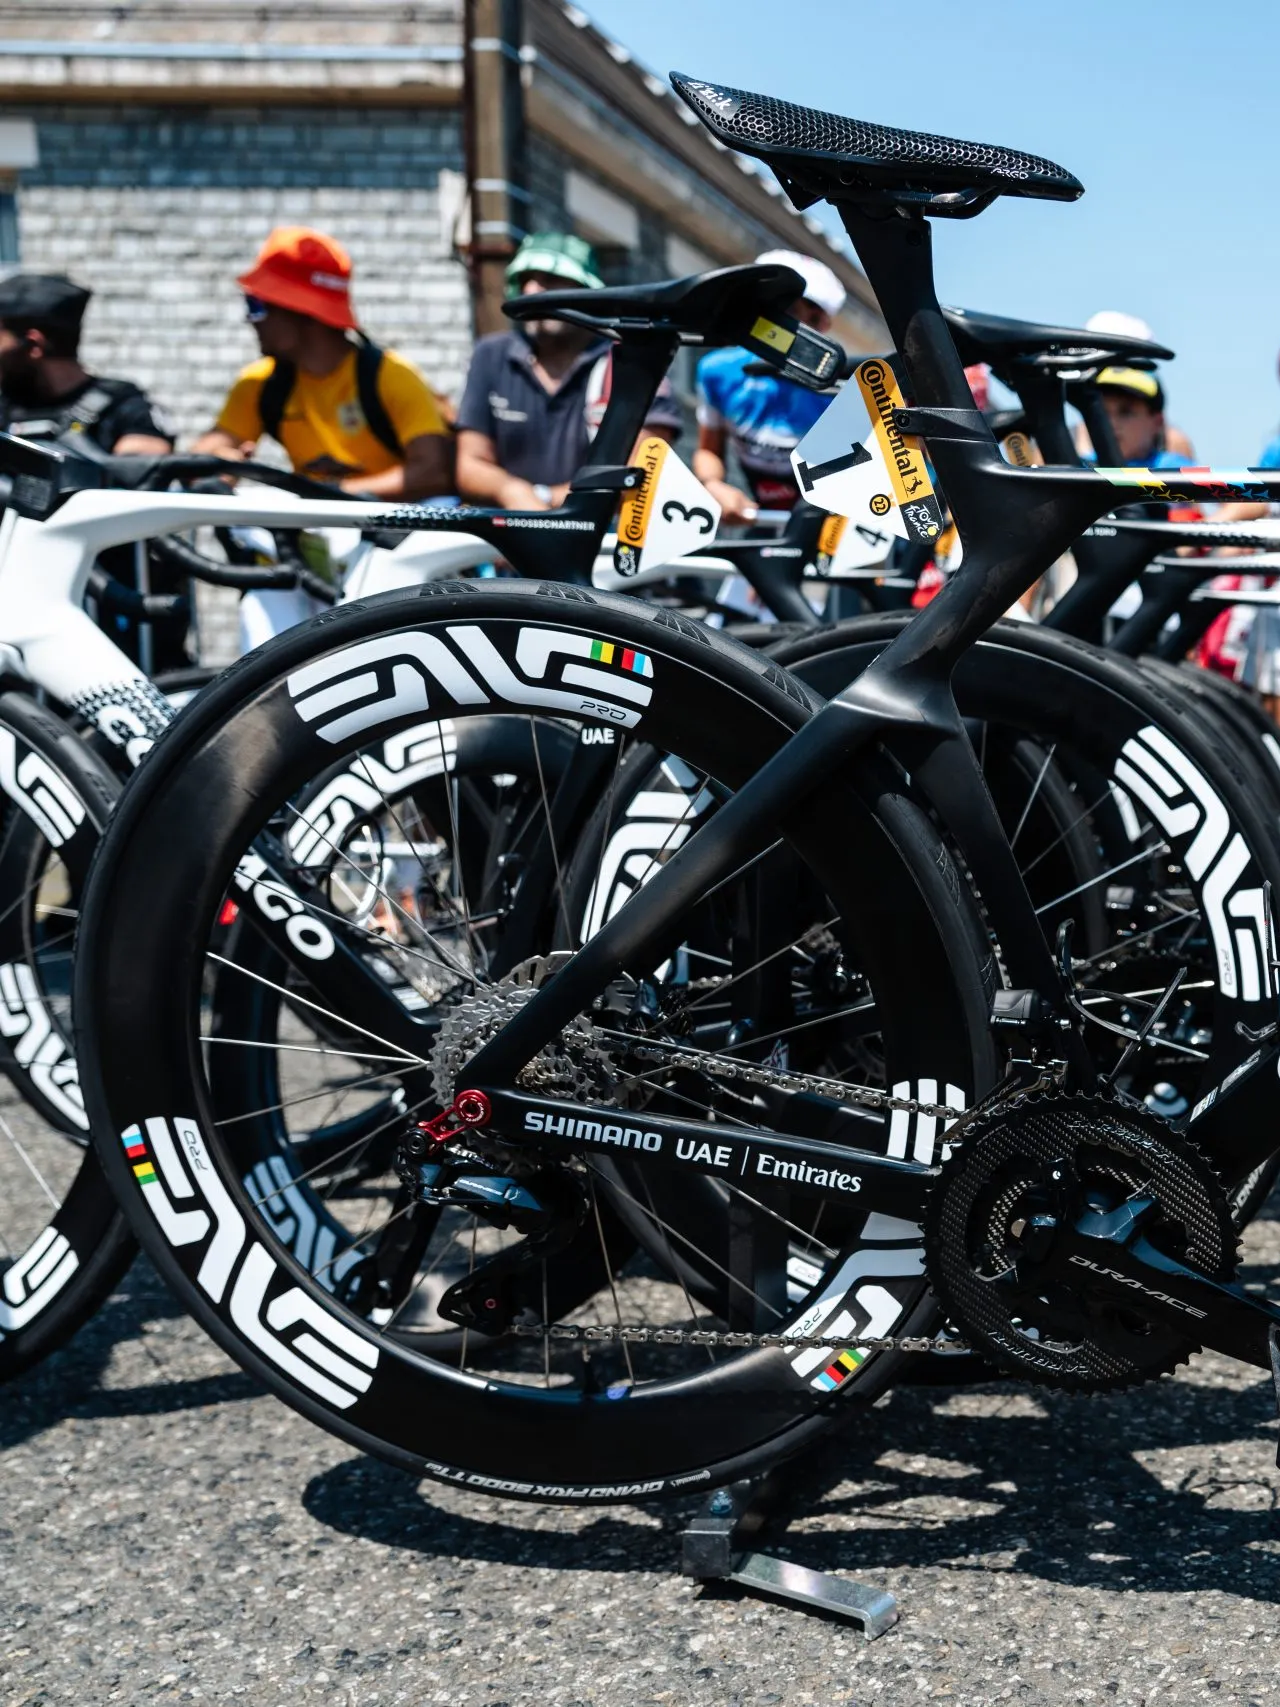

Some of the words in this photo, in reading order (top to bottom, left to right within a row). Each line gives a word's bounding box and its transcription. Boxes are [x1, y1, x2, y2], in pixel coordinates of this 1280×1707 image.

[990, 167, 1029, 180] ARGO
[860, 360, 918, 478] Continental
[797, 441, 873, 492] 1
[662, 500, 714, 535] 3
[855, 524, 888, 547] 4
[580, 701, 626, 720] PRO
[581, 727, 615, 745] UAE
[524, 1111, 662, 1152] SHIMANO
[183, 1130, 208, 1171] PRO
[675, 1138, 733, 1167] UAE
[757, 1154, 862, 1193] Emirates
[1068, 1255, 1208, 1319] DURA-ACE
[465, 1475, 534, 1494] 5000
[533, 1485, 587, 1498] PRIX
[589, 1480, 665, 1498] GRAND
